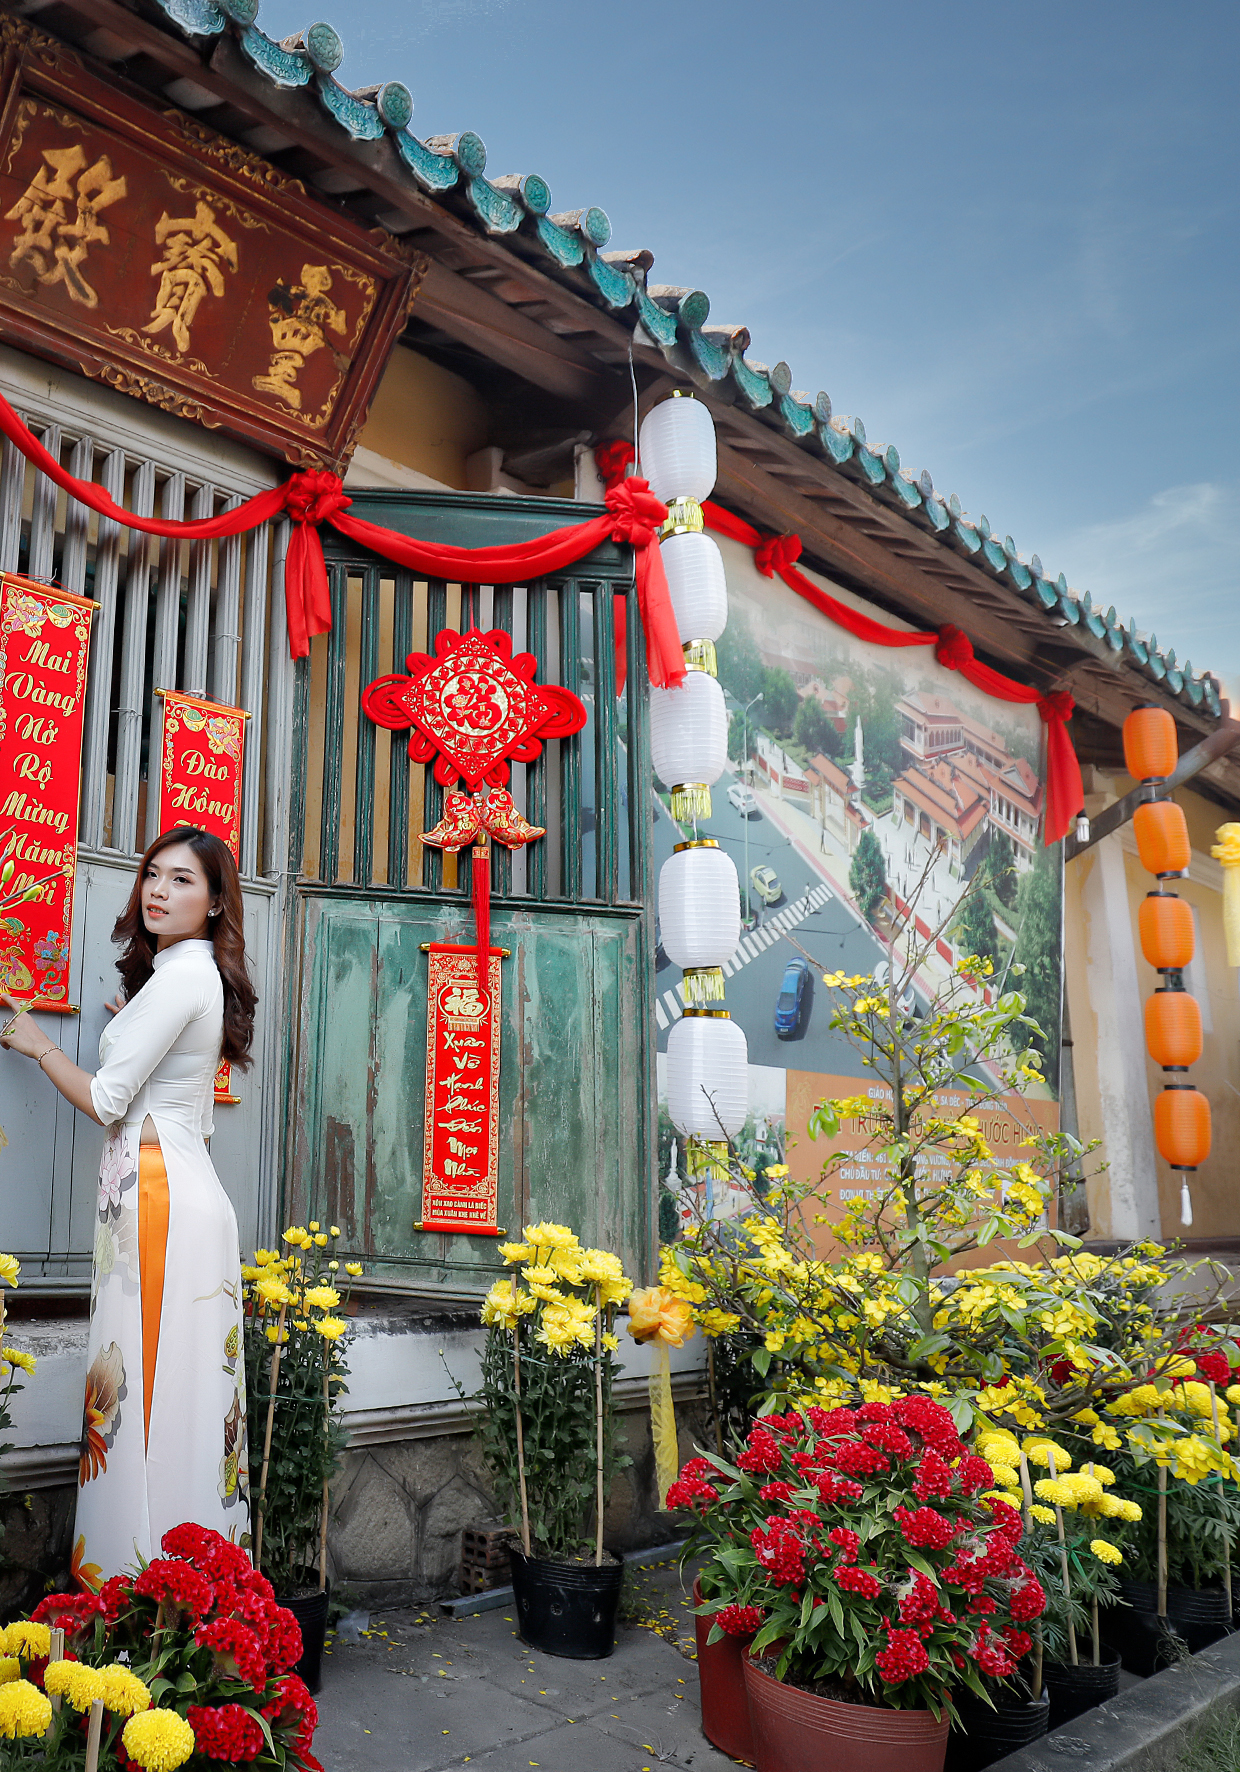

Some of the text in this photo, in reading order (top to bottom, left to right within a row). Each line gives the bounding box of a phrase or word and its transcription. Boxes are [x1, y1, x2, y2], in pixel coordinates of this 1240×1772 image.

[19, 640, 73, 674] Mai
[5, 672, 76, 717] Vàng
[15, 713, 59, 745] Nở
[13, 753, 53, 790] Rộ
[180, 749, 230, 781] Đào
[170, 783, 234, 824] Hồng
[444, 987, 484, 1017] 福
[443, 1031, 486, 1053] Xuân
[452, 1051, 482, 1070] Về
[439, 1072, 484, 1096] Hạnh
[436, 1094, 487, 1115] Phúc
[438, 1118, 483, 1134] Đến
[445, 1136, 479, 1161] Mọi
[444, 1159, 481, 1179] Nhà
